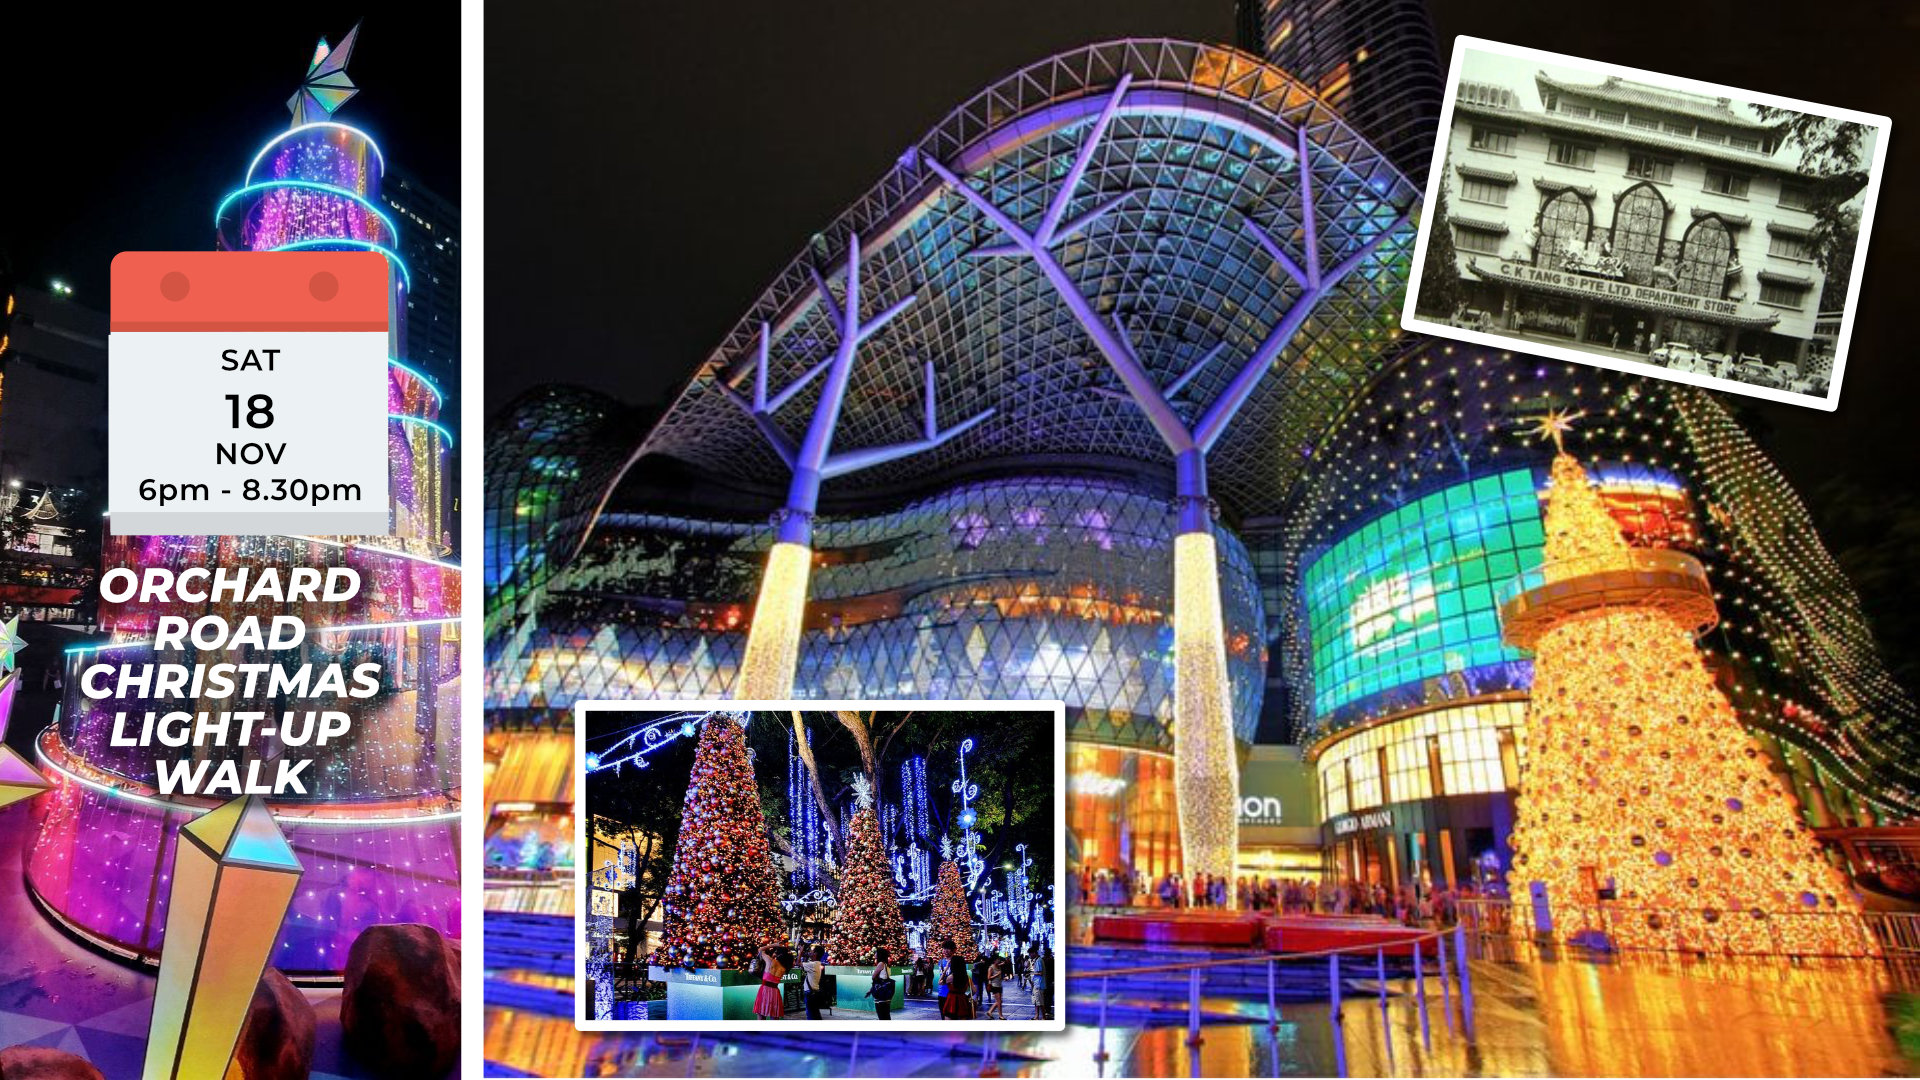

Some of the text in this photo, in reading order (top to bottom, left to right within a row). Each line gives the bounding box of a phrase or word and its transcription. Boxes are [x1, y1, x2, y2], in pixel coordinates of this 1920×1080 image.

[1528, 269, 1561, 285] TANG
[1608, 285, 1633, 298] LTD.
[1635, 288, 1700, 309] DEPARTMENT
[1703, 300, 1738, 315] STORE
